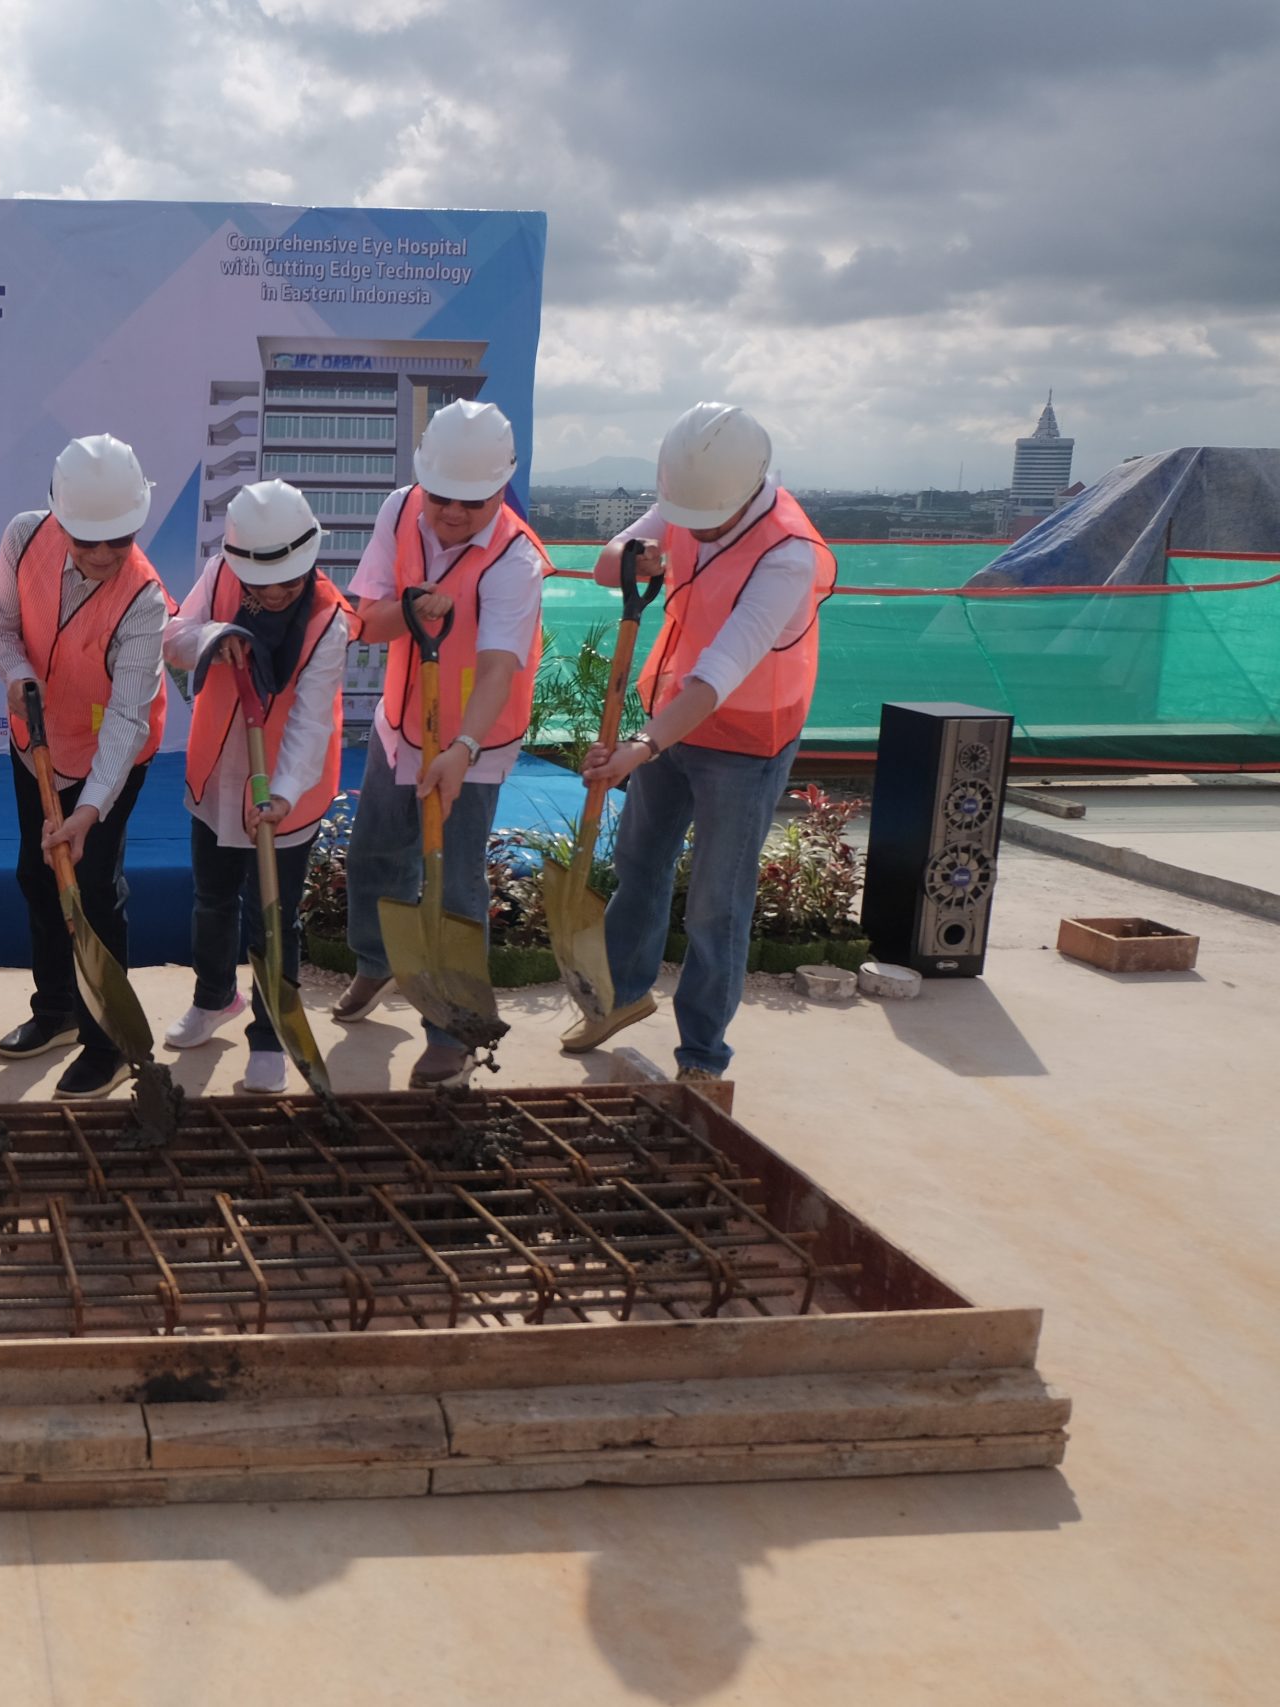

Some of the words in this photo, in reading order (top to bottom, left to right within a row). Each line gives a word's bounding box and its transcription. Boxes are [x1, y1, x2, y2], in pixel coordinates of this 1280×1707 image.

[226, 232, 357, 254] Comprehensive
[363, 237, 393, 256] Eye
[398, 238, 468, 258] Hospital
[220, 259, 260, 276] with
[263, 260, 325, 280] Cutting
[330, 261, 371, 280] Edge
[377, 262, 472, 285] Technology
[262, 283, 277, 300] in
[281, 285, 346, 302] Eastern
[351, 286, 431, 304] Indonesia
